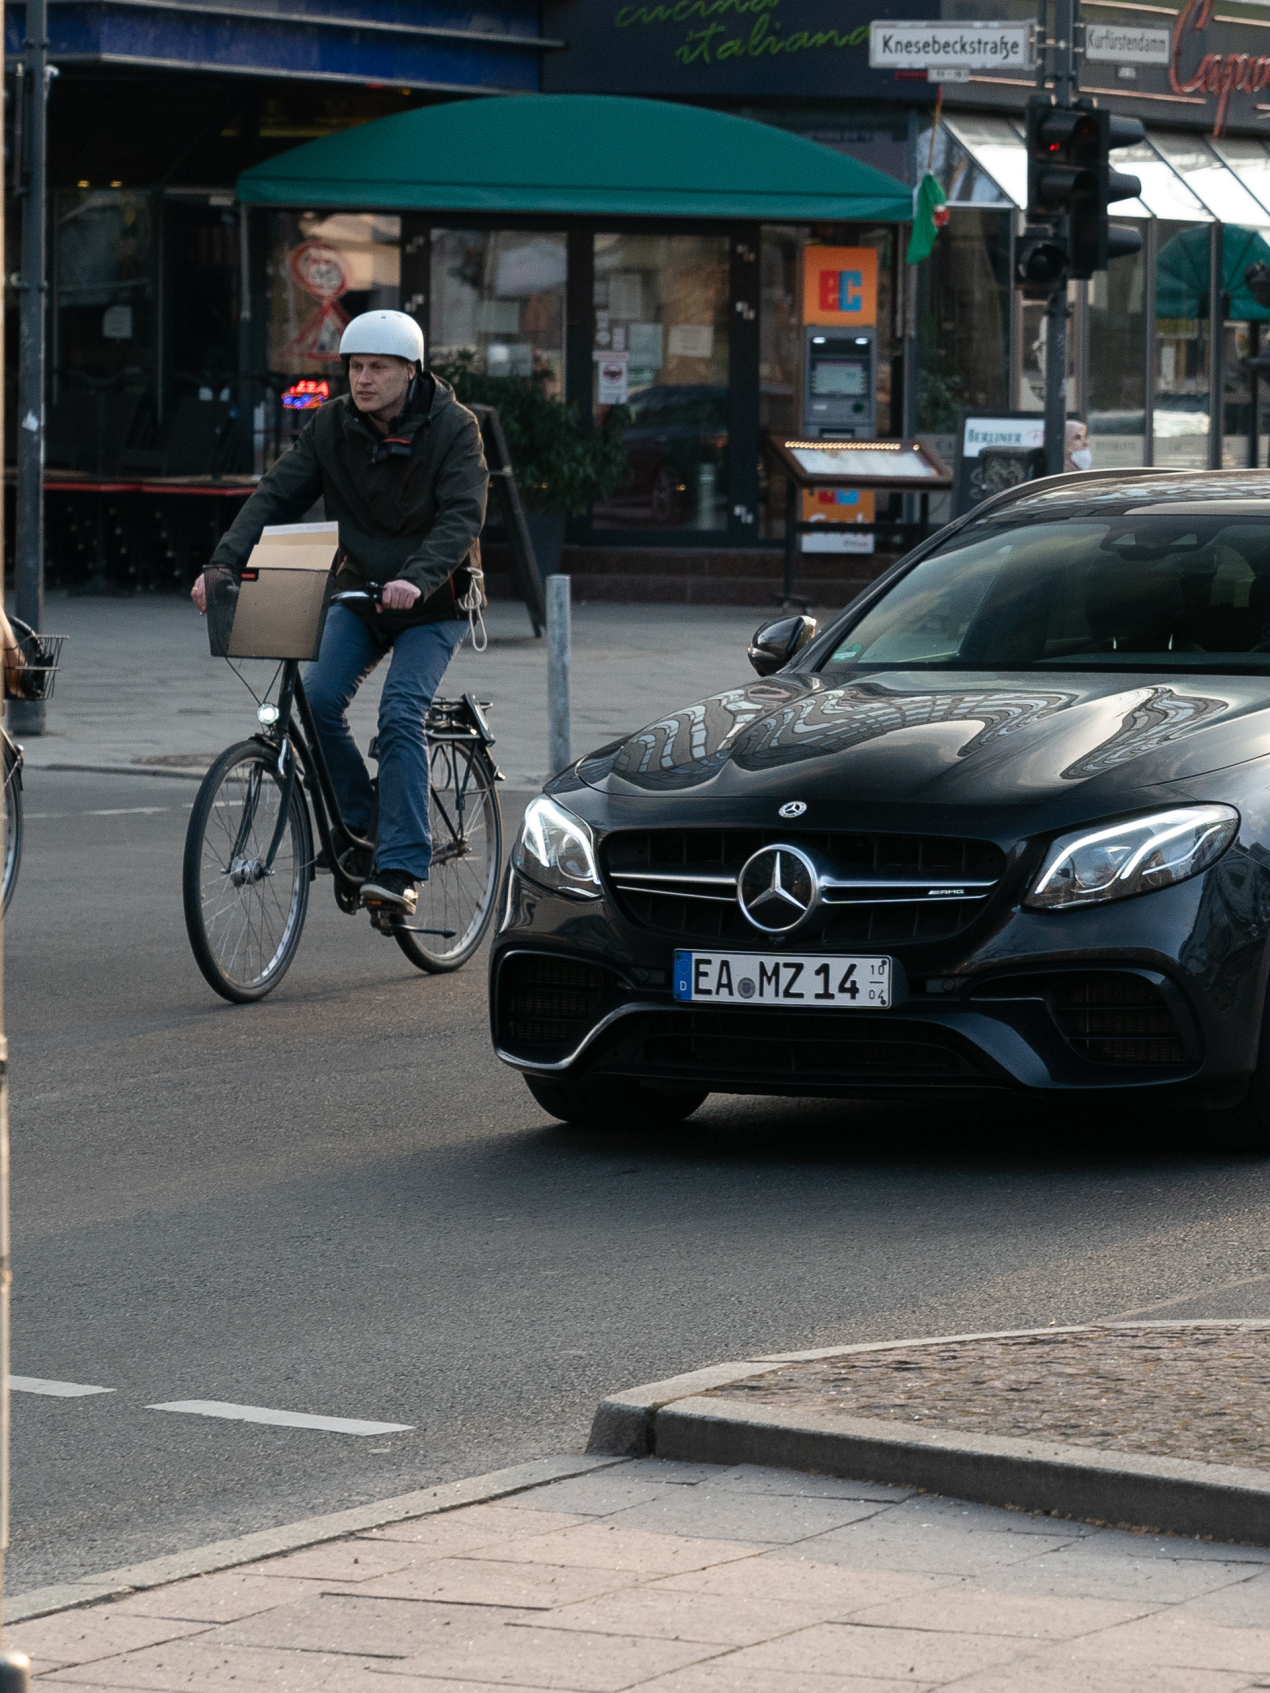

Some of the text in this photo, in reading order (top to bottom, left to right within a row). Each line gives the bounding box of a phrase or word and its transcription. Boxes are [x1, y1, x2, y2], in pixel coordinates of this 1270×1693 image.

[882, 33, 1019, 60] Knesebeckstraße
[1087, 29, 1167, 54] Kurfürstendamm
[693, 958, 860, 1000] EA MZ 14
[870, 963, 886, 976] 10
[679, 980, 688, 991] D
